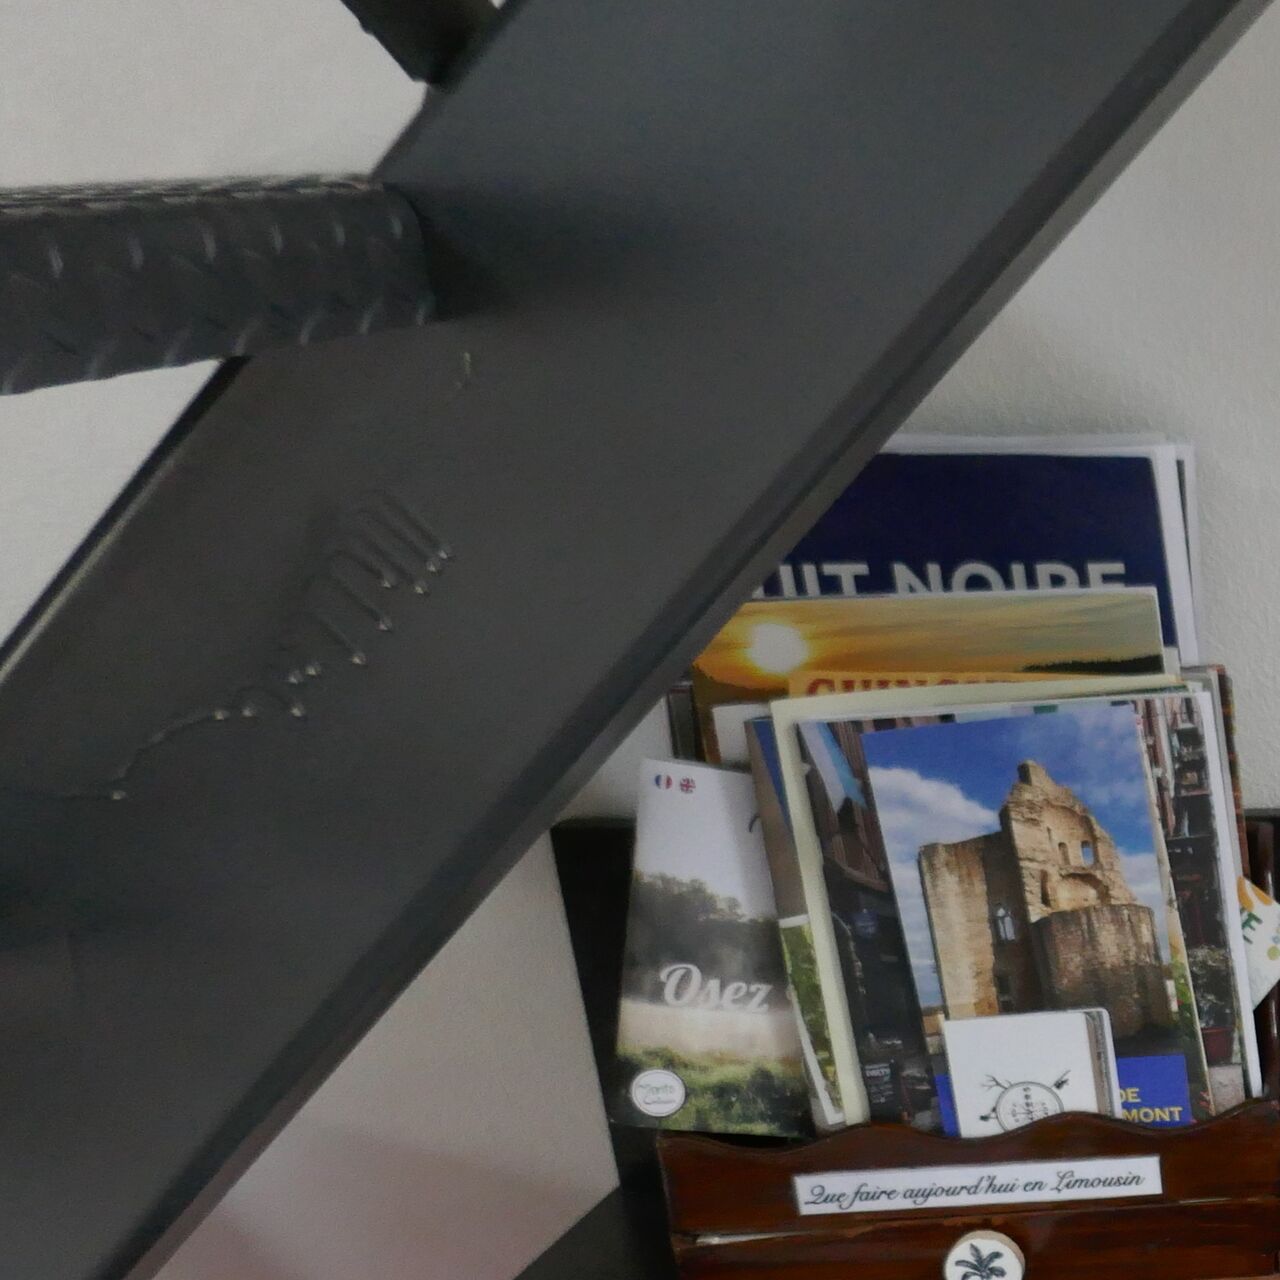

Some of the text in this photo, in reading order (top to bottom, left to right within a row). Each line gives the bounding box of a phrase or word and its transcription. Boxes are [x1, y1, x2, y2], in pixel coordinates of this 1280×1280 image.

[660, 963, 774, 1013] Osez
[804, 1170, 1146, 1210] Que faire aujourd'hui en Limousin
